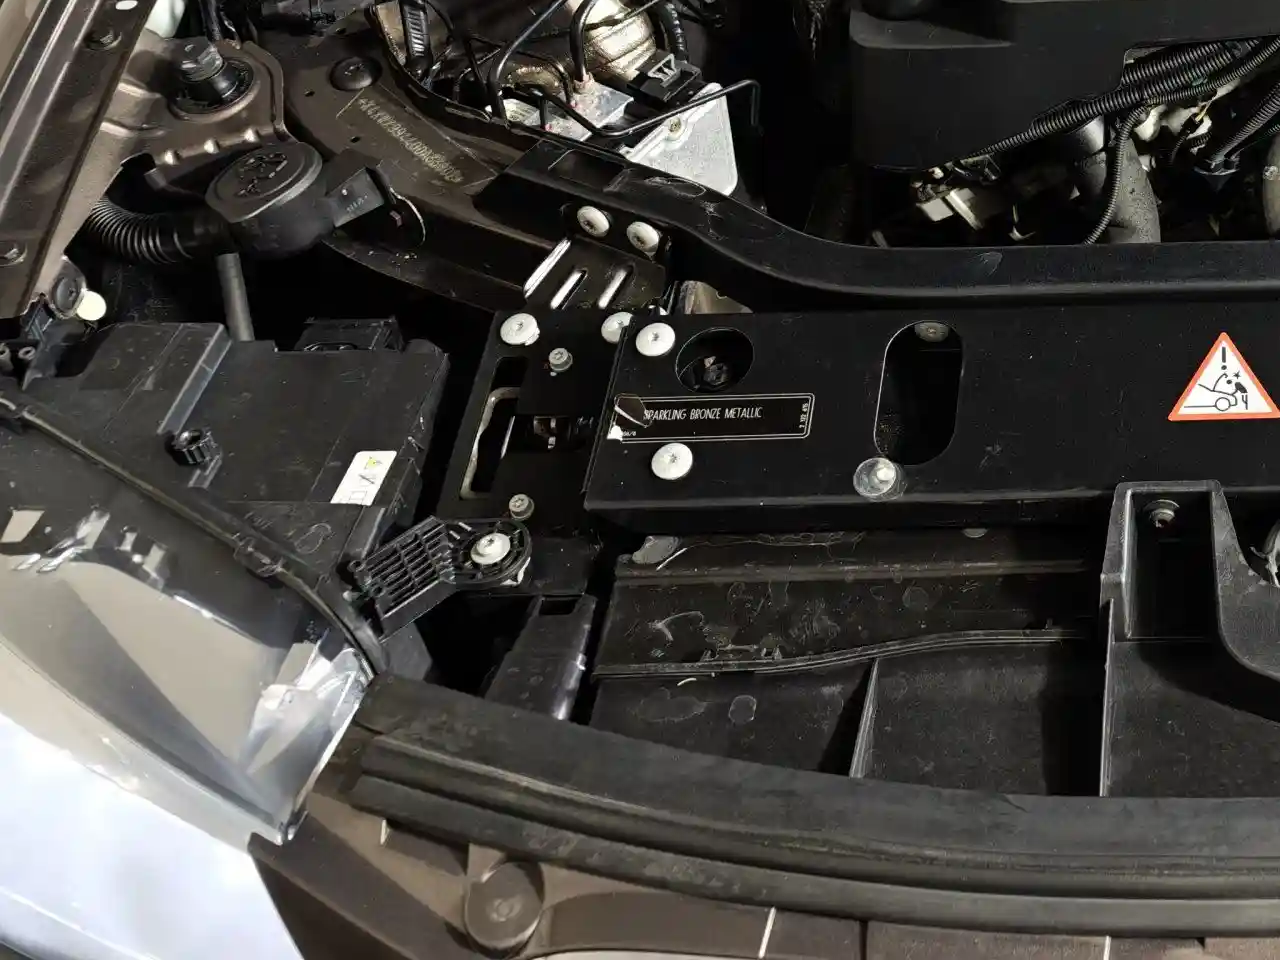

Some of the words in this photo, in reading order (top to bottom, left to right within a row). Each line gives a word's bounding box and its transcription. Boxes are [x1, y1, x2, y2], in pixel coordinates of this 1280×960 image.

[643, 407, 687, 421] SPARKLING
[690, 407, 720, 420] BRONZE
[724, 406, 763, 419] METALLIC
